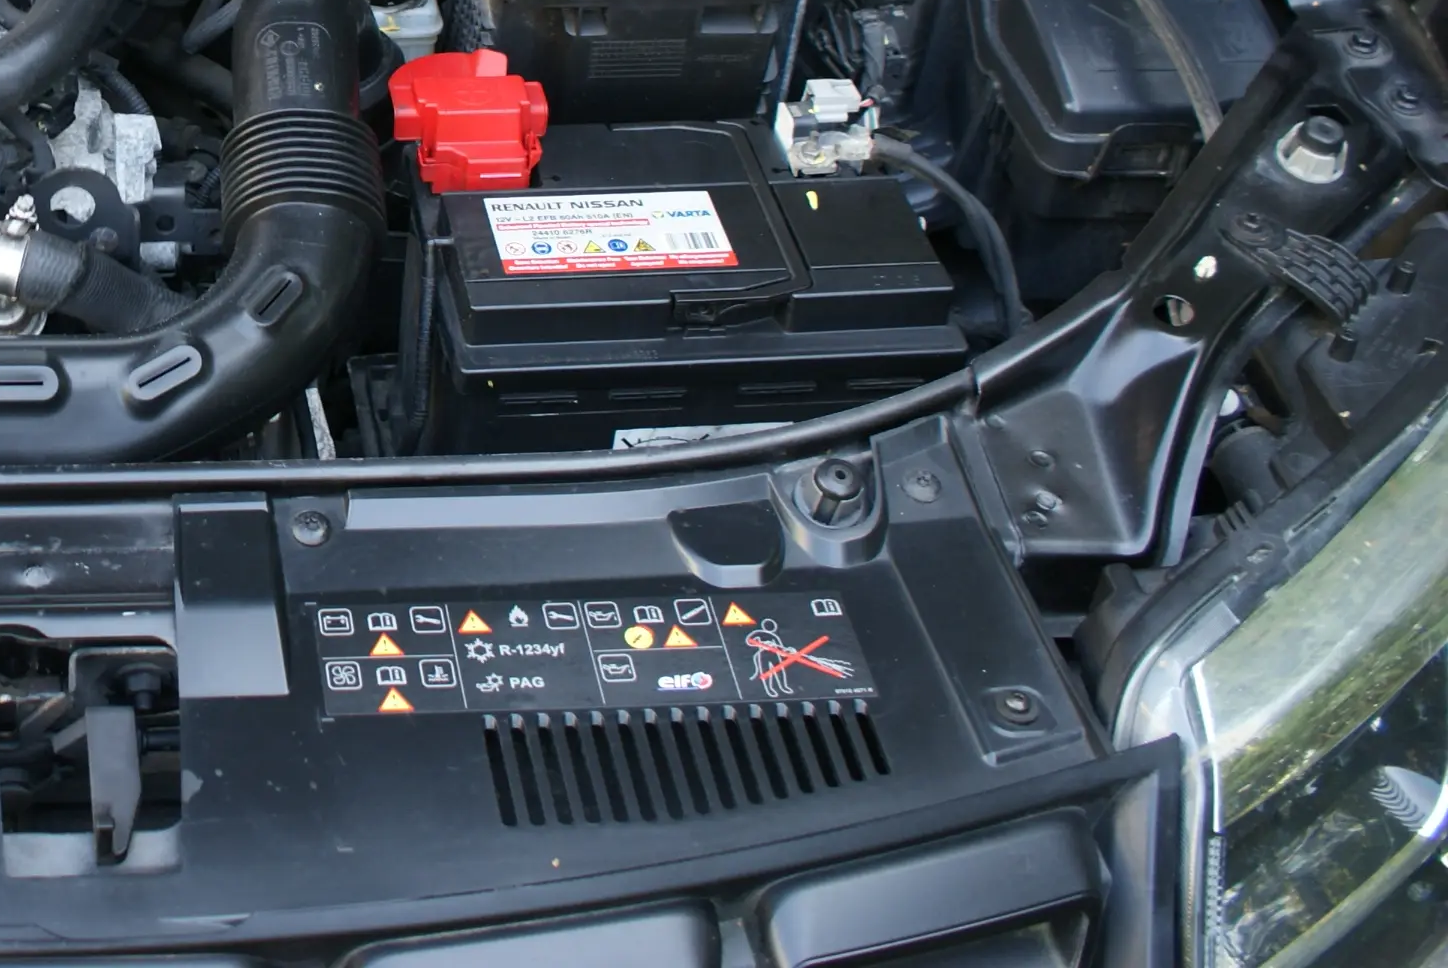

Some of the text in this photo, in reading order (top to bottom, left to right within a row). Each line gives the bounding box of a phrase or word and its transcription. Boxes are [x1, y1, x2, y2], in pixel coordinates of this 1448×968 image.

[491, 199, 644, 213] RENAULT NISSAN
[666, 210, 711, 218] VARTA
[499, 642, 565, 658] R-1234yf
[509, 677, 545, 690] PAG
[658, 674, 692, 689] elf
